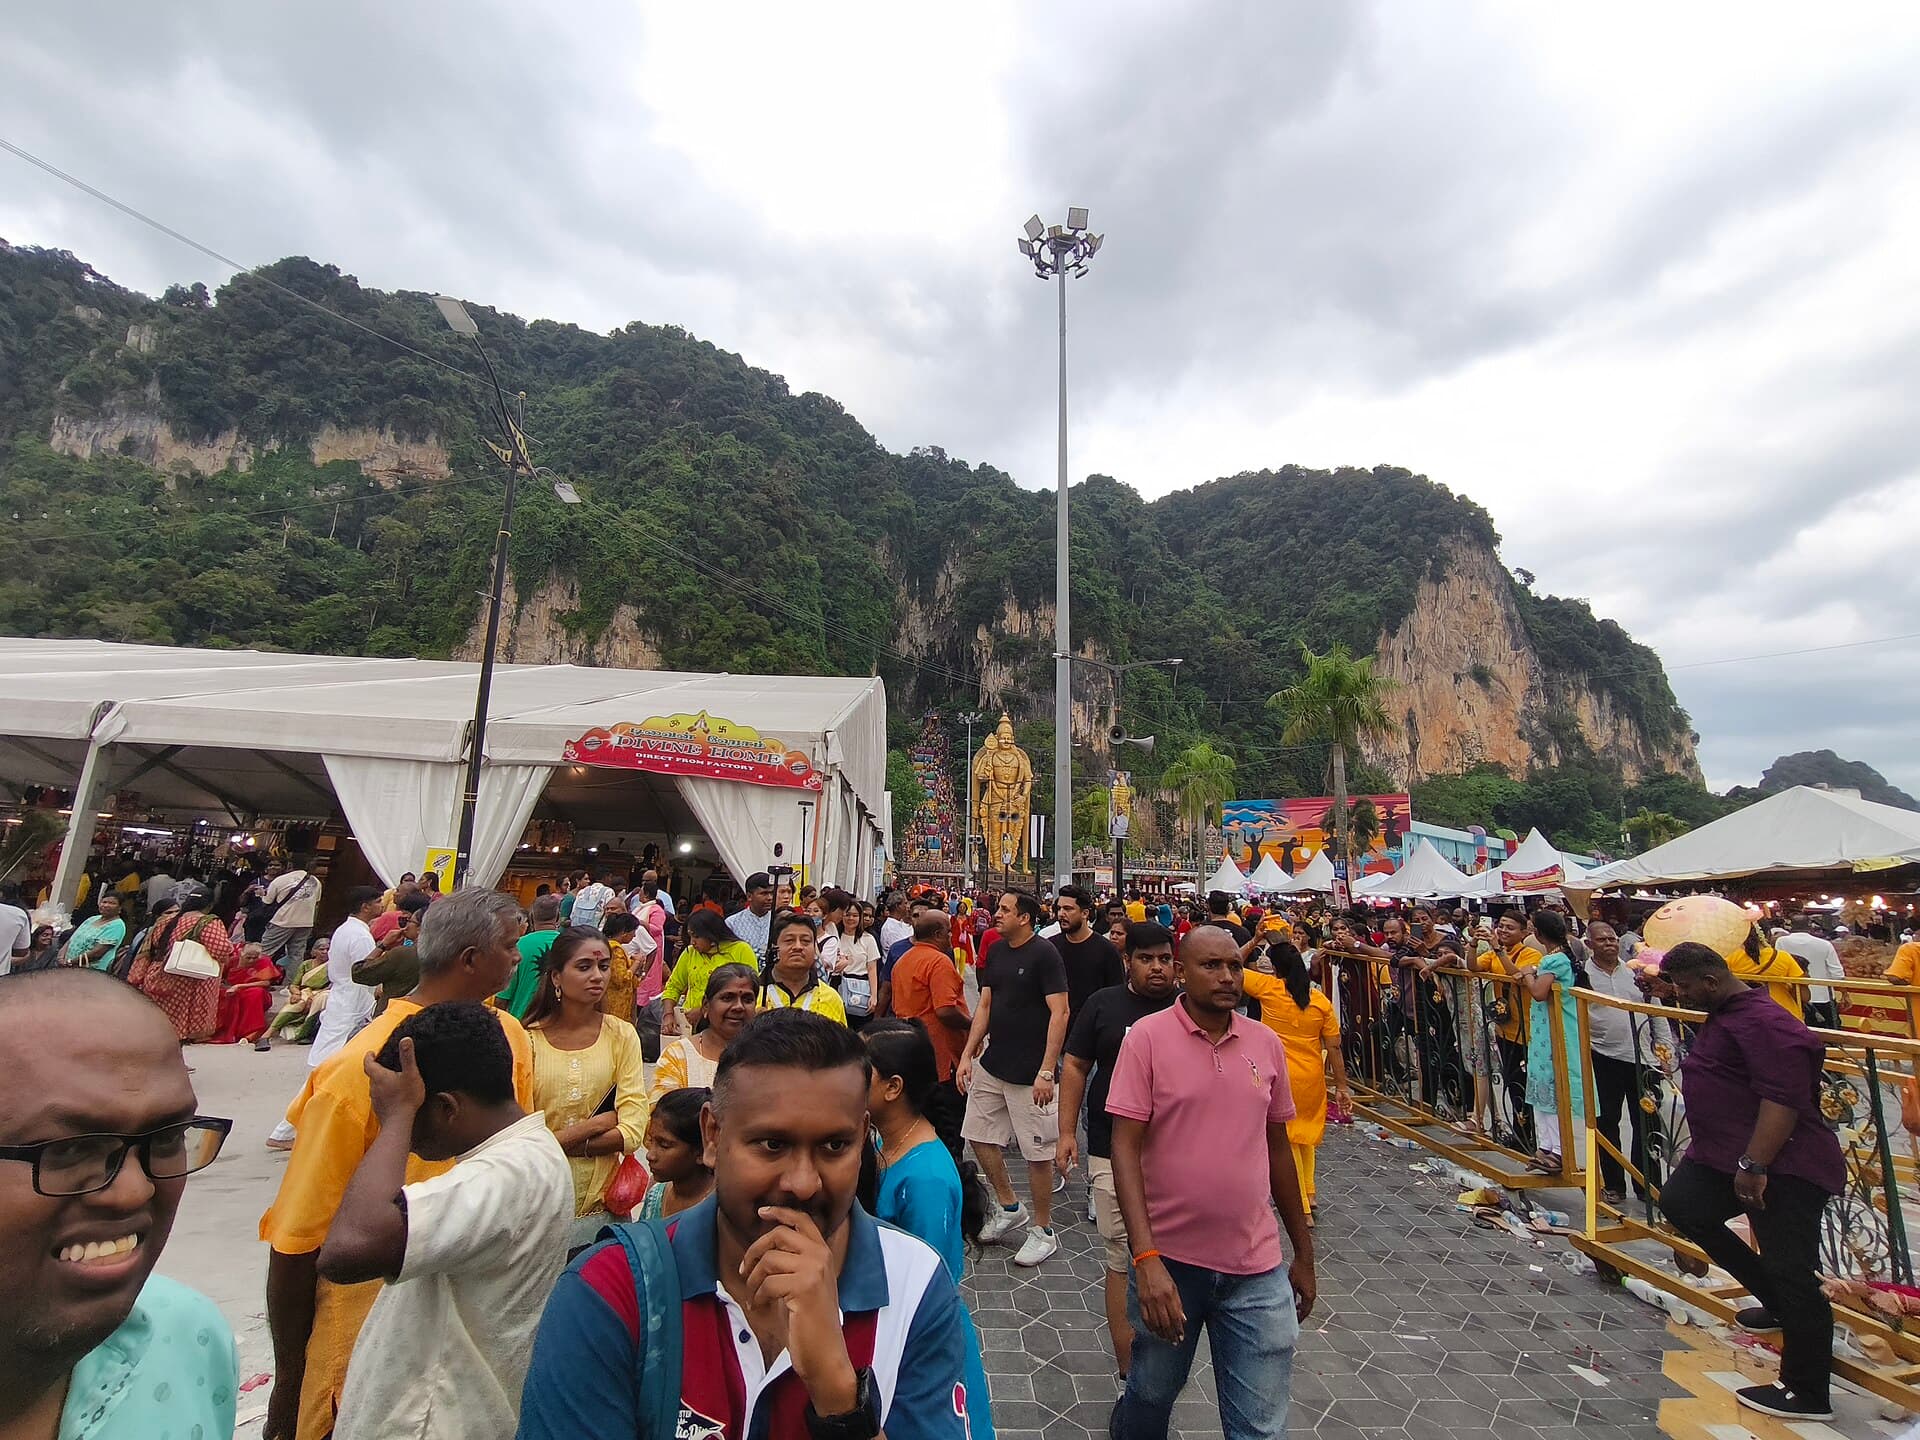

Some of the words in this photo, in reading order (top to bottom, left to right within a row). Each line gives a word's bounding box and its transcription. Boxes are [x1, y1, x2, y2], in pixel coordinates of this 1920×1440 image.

[615, 734, 702, 755] DIVINE
[707, 745, 783, 766] HOME
[635, 752, 674, 761] DIRECT
[676, 757, 704, 765] FROM
[707, 758, 755, 771] FACTORY
